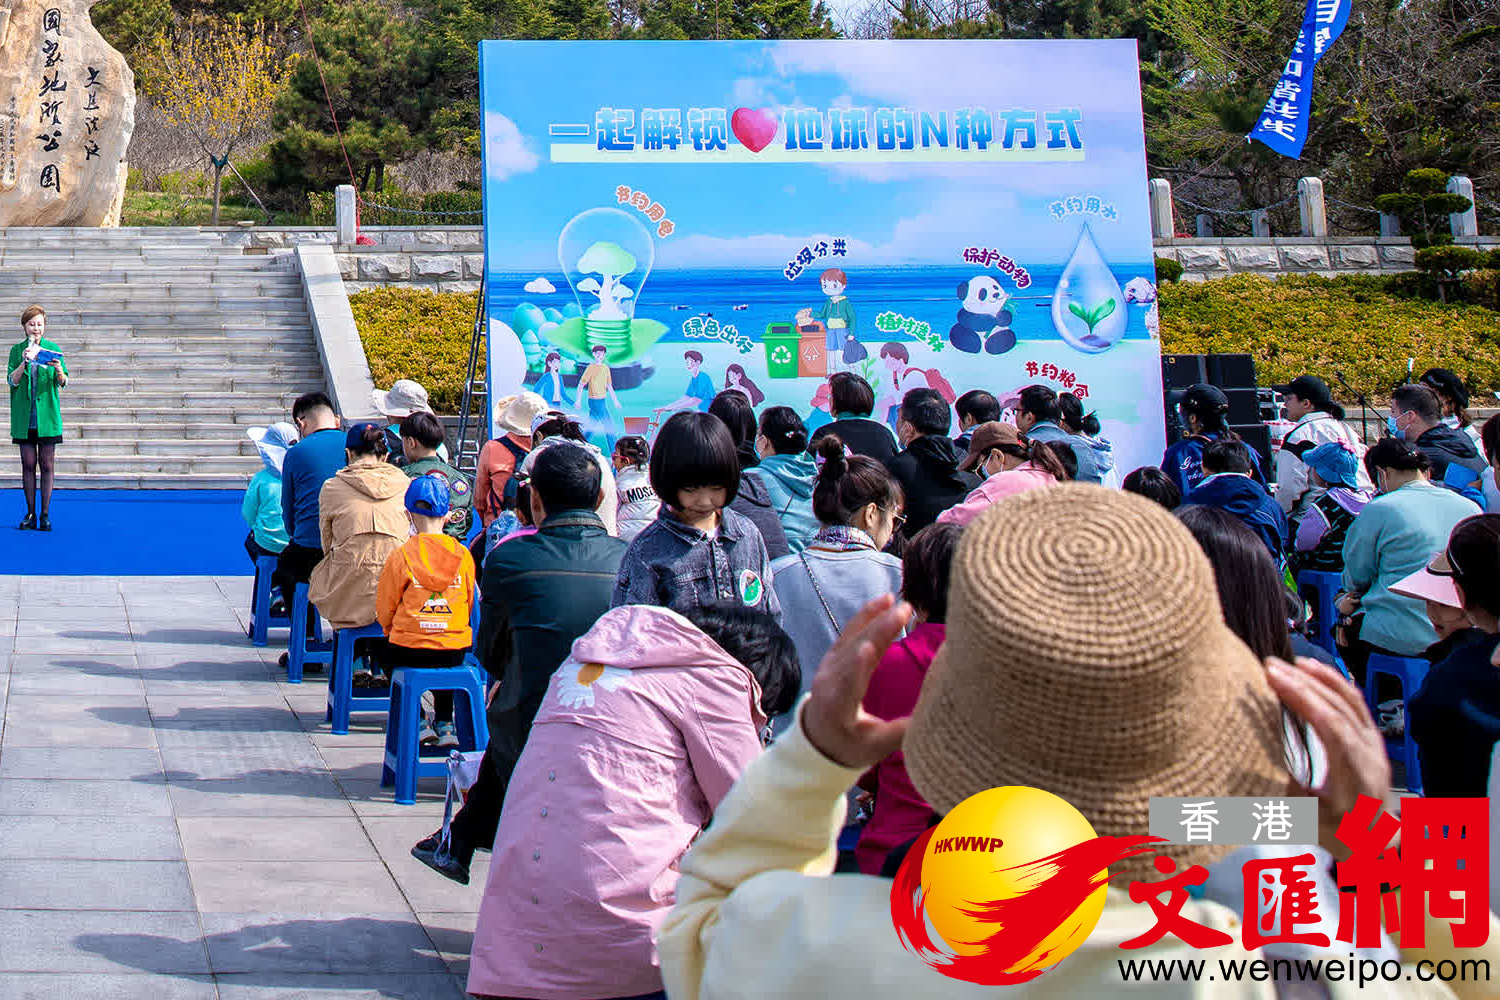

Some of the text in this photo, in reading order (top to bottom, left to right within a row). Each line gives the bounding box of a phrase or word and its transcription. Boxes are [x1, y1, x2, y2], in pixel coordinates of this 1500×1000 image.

[548, 106, 1085, 152] 一起解锁 地球的N种方式
[616, 184, 675, 238] 节约用电
[1050, 196, 1117, 220] 节约用水
[784, 238, 847, 281] 垃圾分类
[962, 247, 1032, 289] 保护动物
[683, 317, 755, 355] 绿色出行
[875, 310, 945, 353] 植树造林
